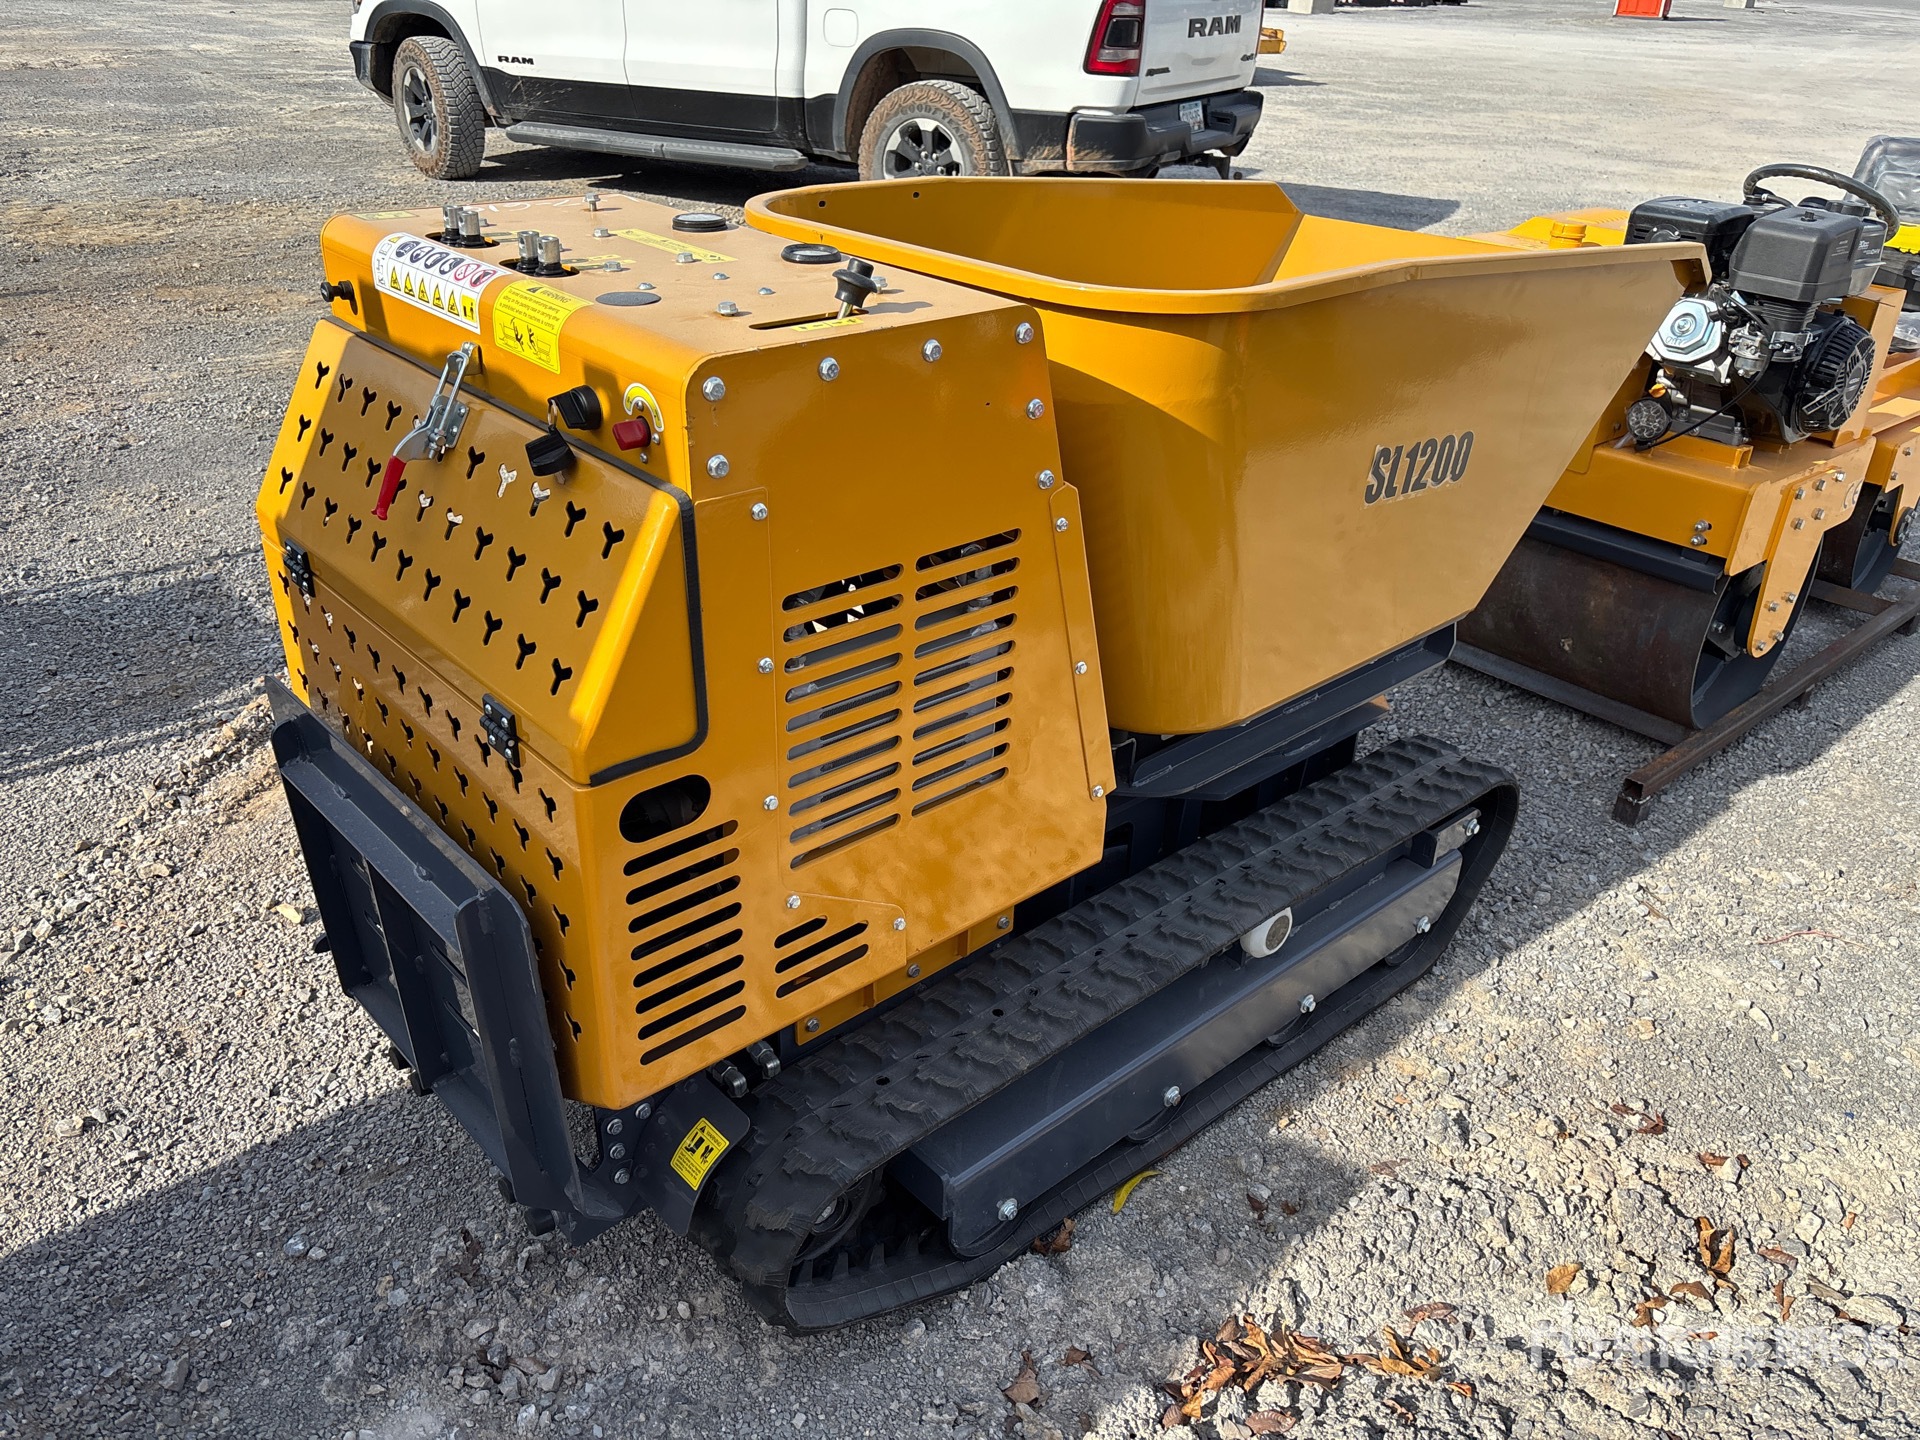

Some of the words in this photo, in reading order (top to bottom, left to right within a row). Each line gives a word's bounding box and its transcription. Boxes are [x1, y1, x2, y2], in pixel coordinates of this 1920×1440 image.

[1187, 15, 1242, 38] RAM
[497, 55, 535, 65] RAM
[1364, 430, 1475, 505] SL1200
